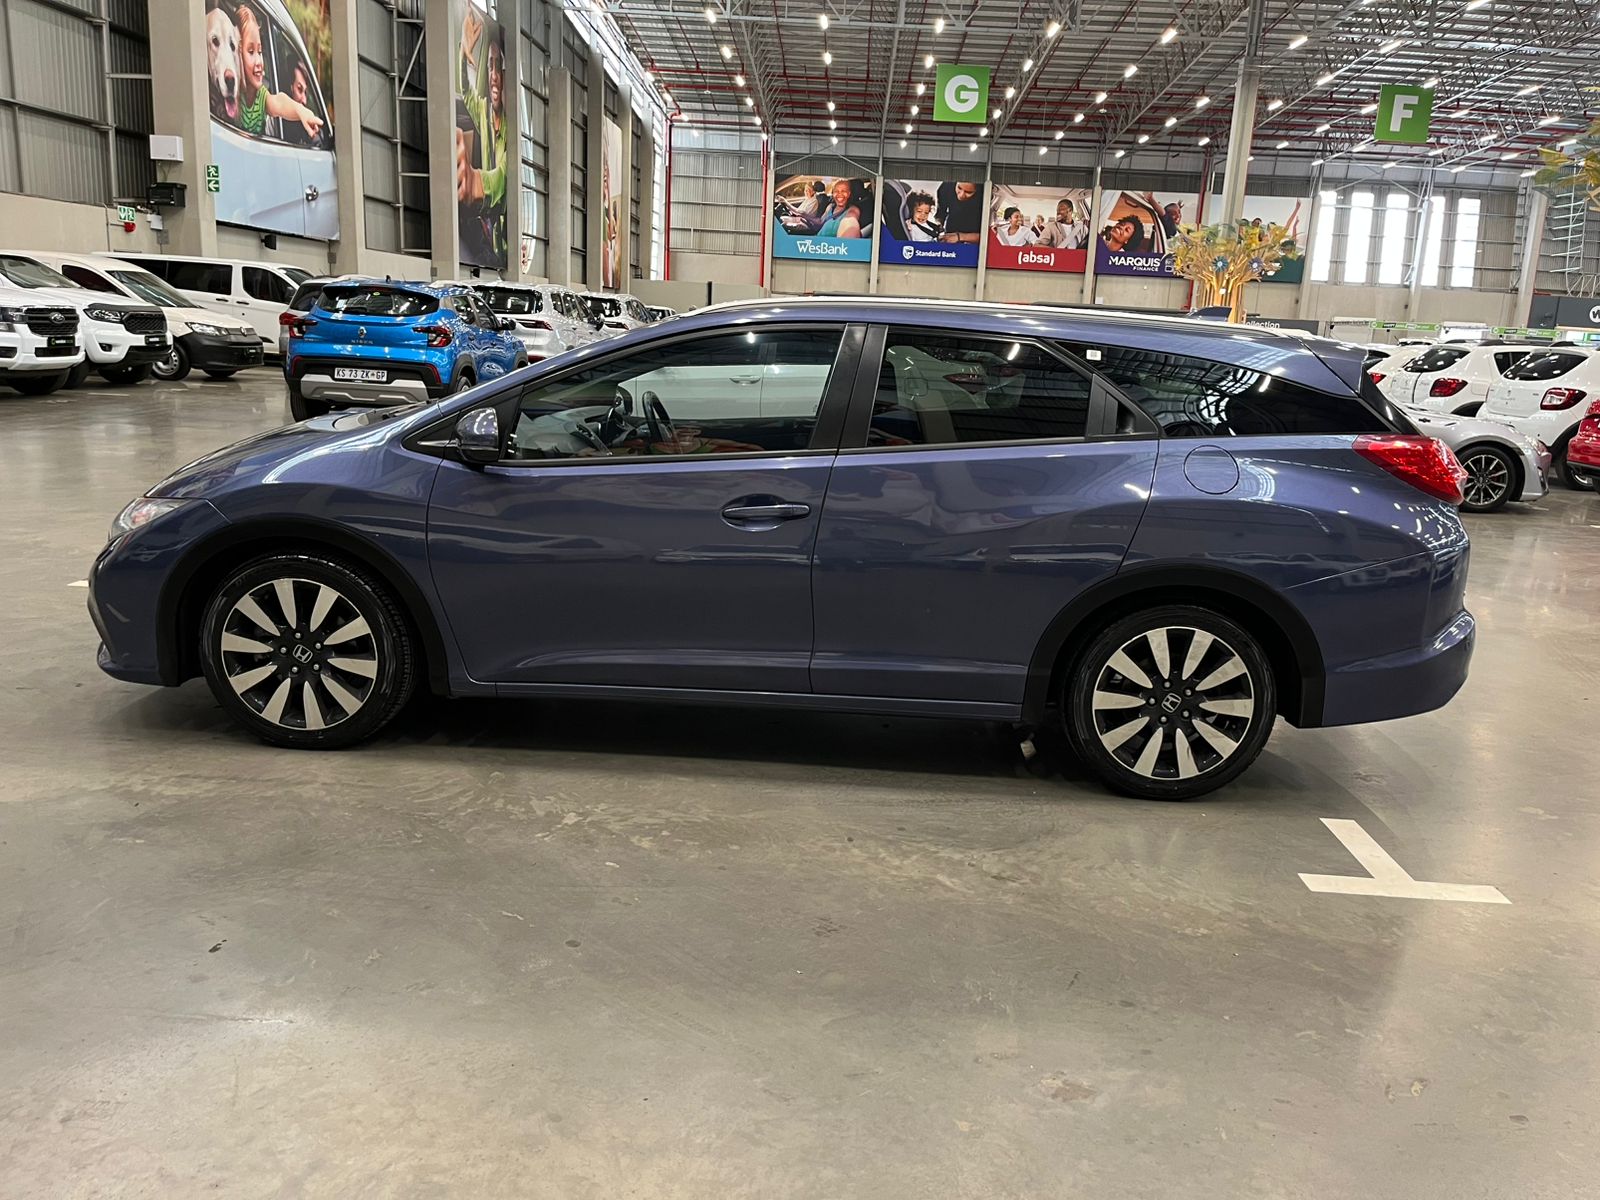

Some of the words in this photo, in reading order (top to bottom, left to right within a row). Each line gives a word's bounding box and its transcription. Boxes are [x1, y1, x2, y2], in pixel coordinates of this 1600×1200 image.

[944, 74, 979, 113] G
[1389, 94, 1419, 132] F
[796, 240, 848, 255] WesBank
[915, 249, 941, 257] Standard
[1109, 255, 1160, 267] MARQUIS
[1244, 320, 1280, 329] ollection
[336, 369, 346, 378] KS
[348, 370, 358, 378] 73
[360, 370, 371, 379] ZK
[376, 371, 385, 380] GP
